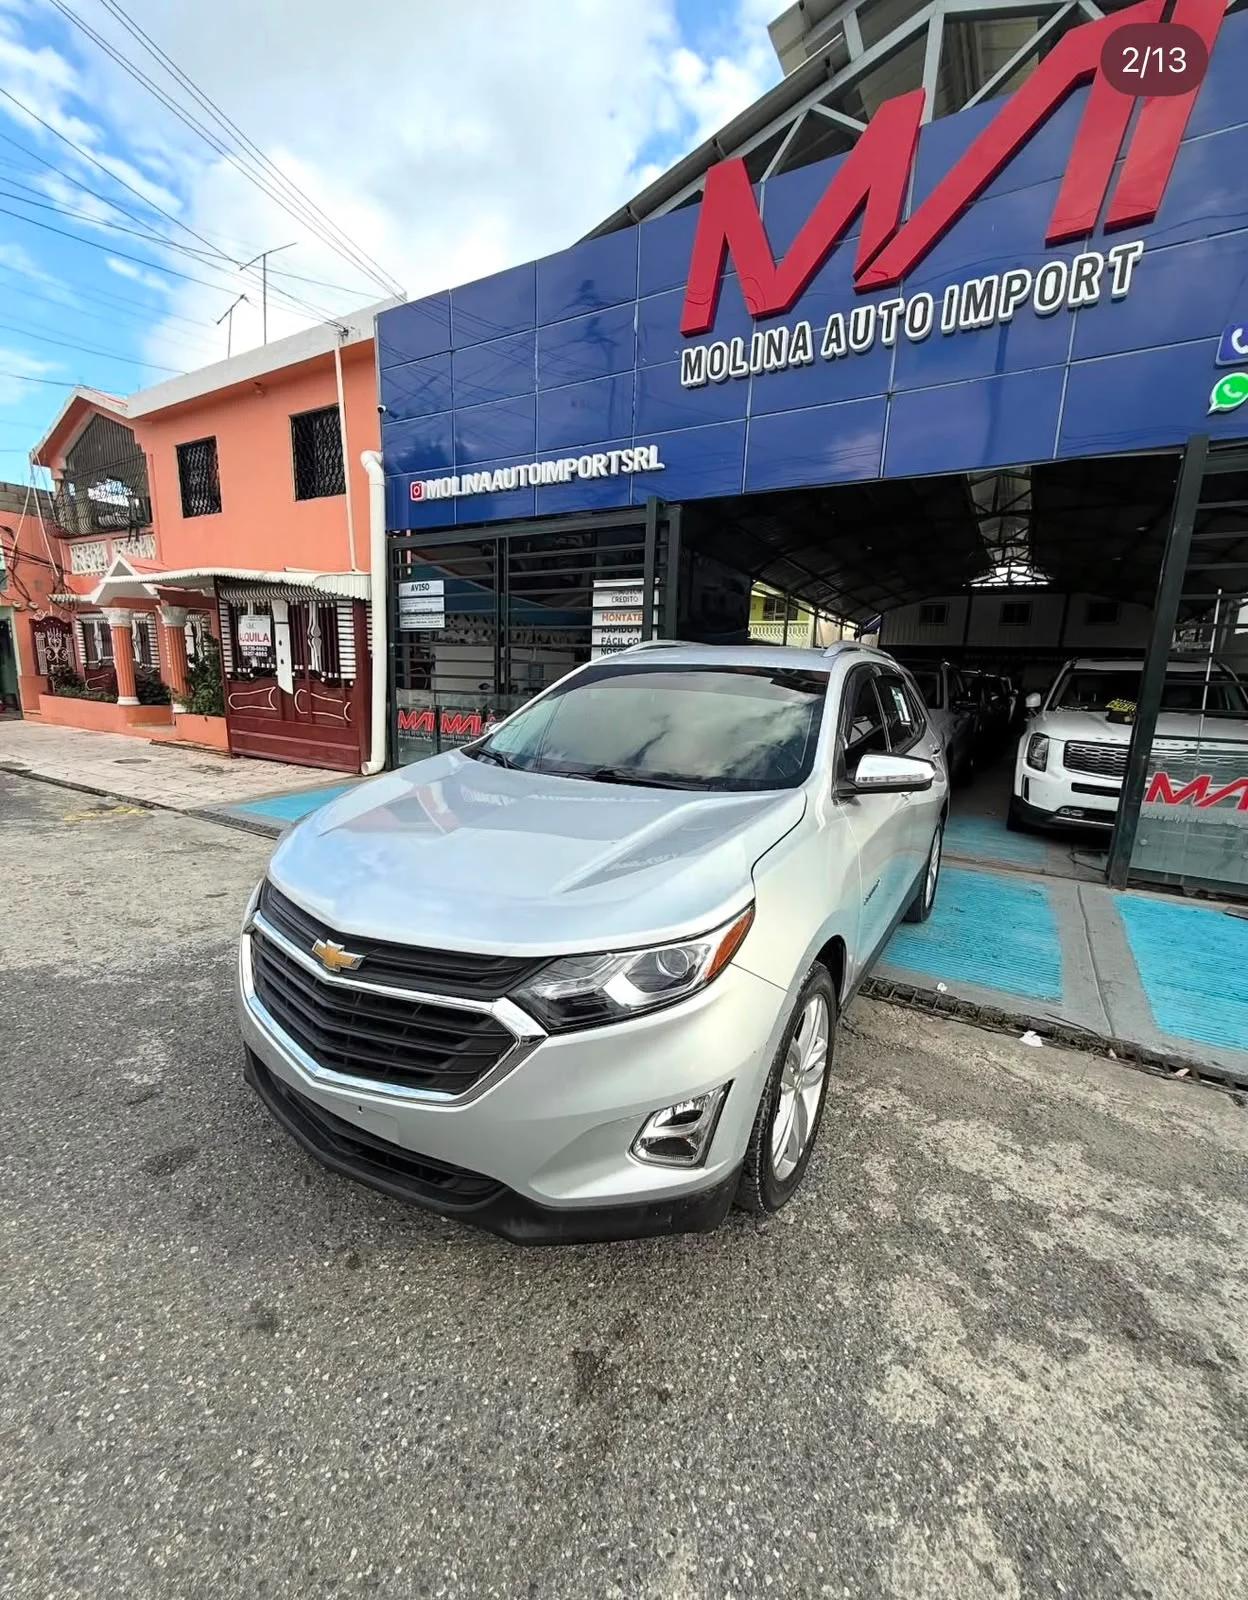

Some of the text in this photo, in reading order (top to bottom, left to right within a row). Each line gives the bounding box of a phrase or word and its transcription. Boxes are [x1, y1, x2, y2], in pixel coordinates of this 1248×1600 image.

[681, 241, 1144, 386] MOLINA AUTO IMPORT
[426, 445, 665, 499] MOLINAAUTOIMPORTSRL
[410, 583, 431, 591] AVISO
